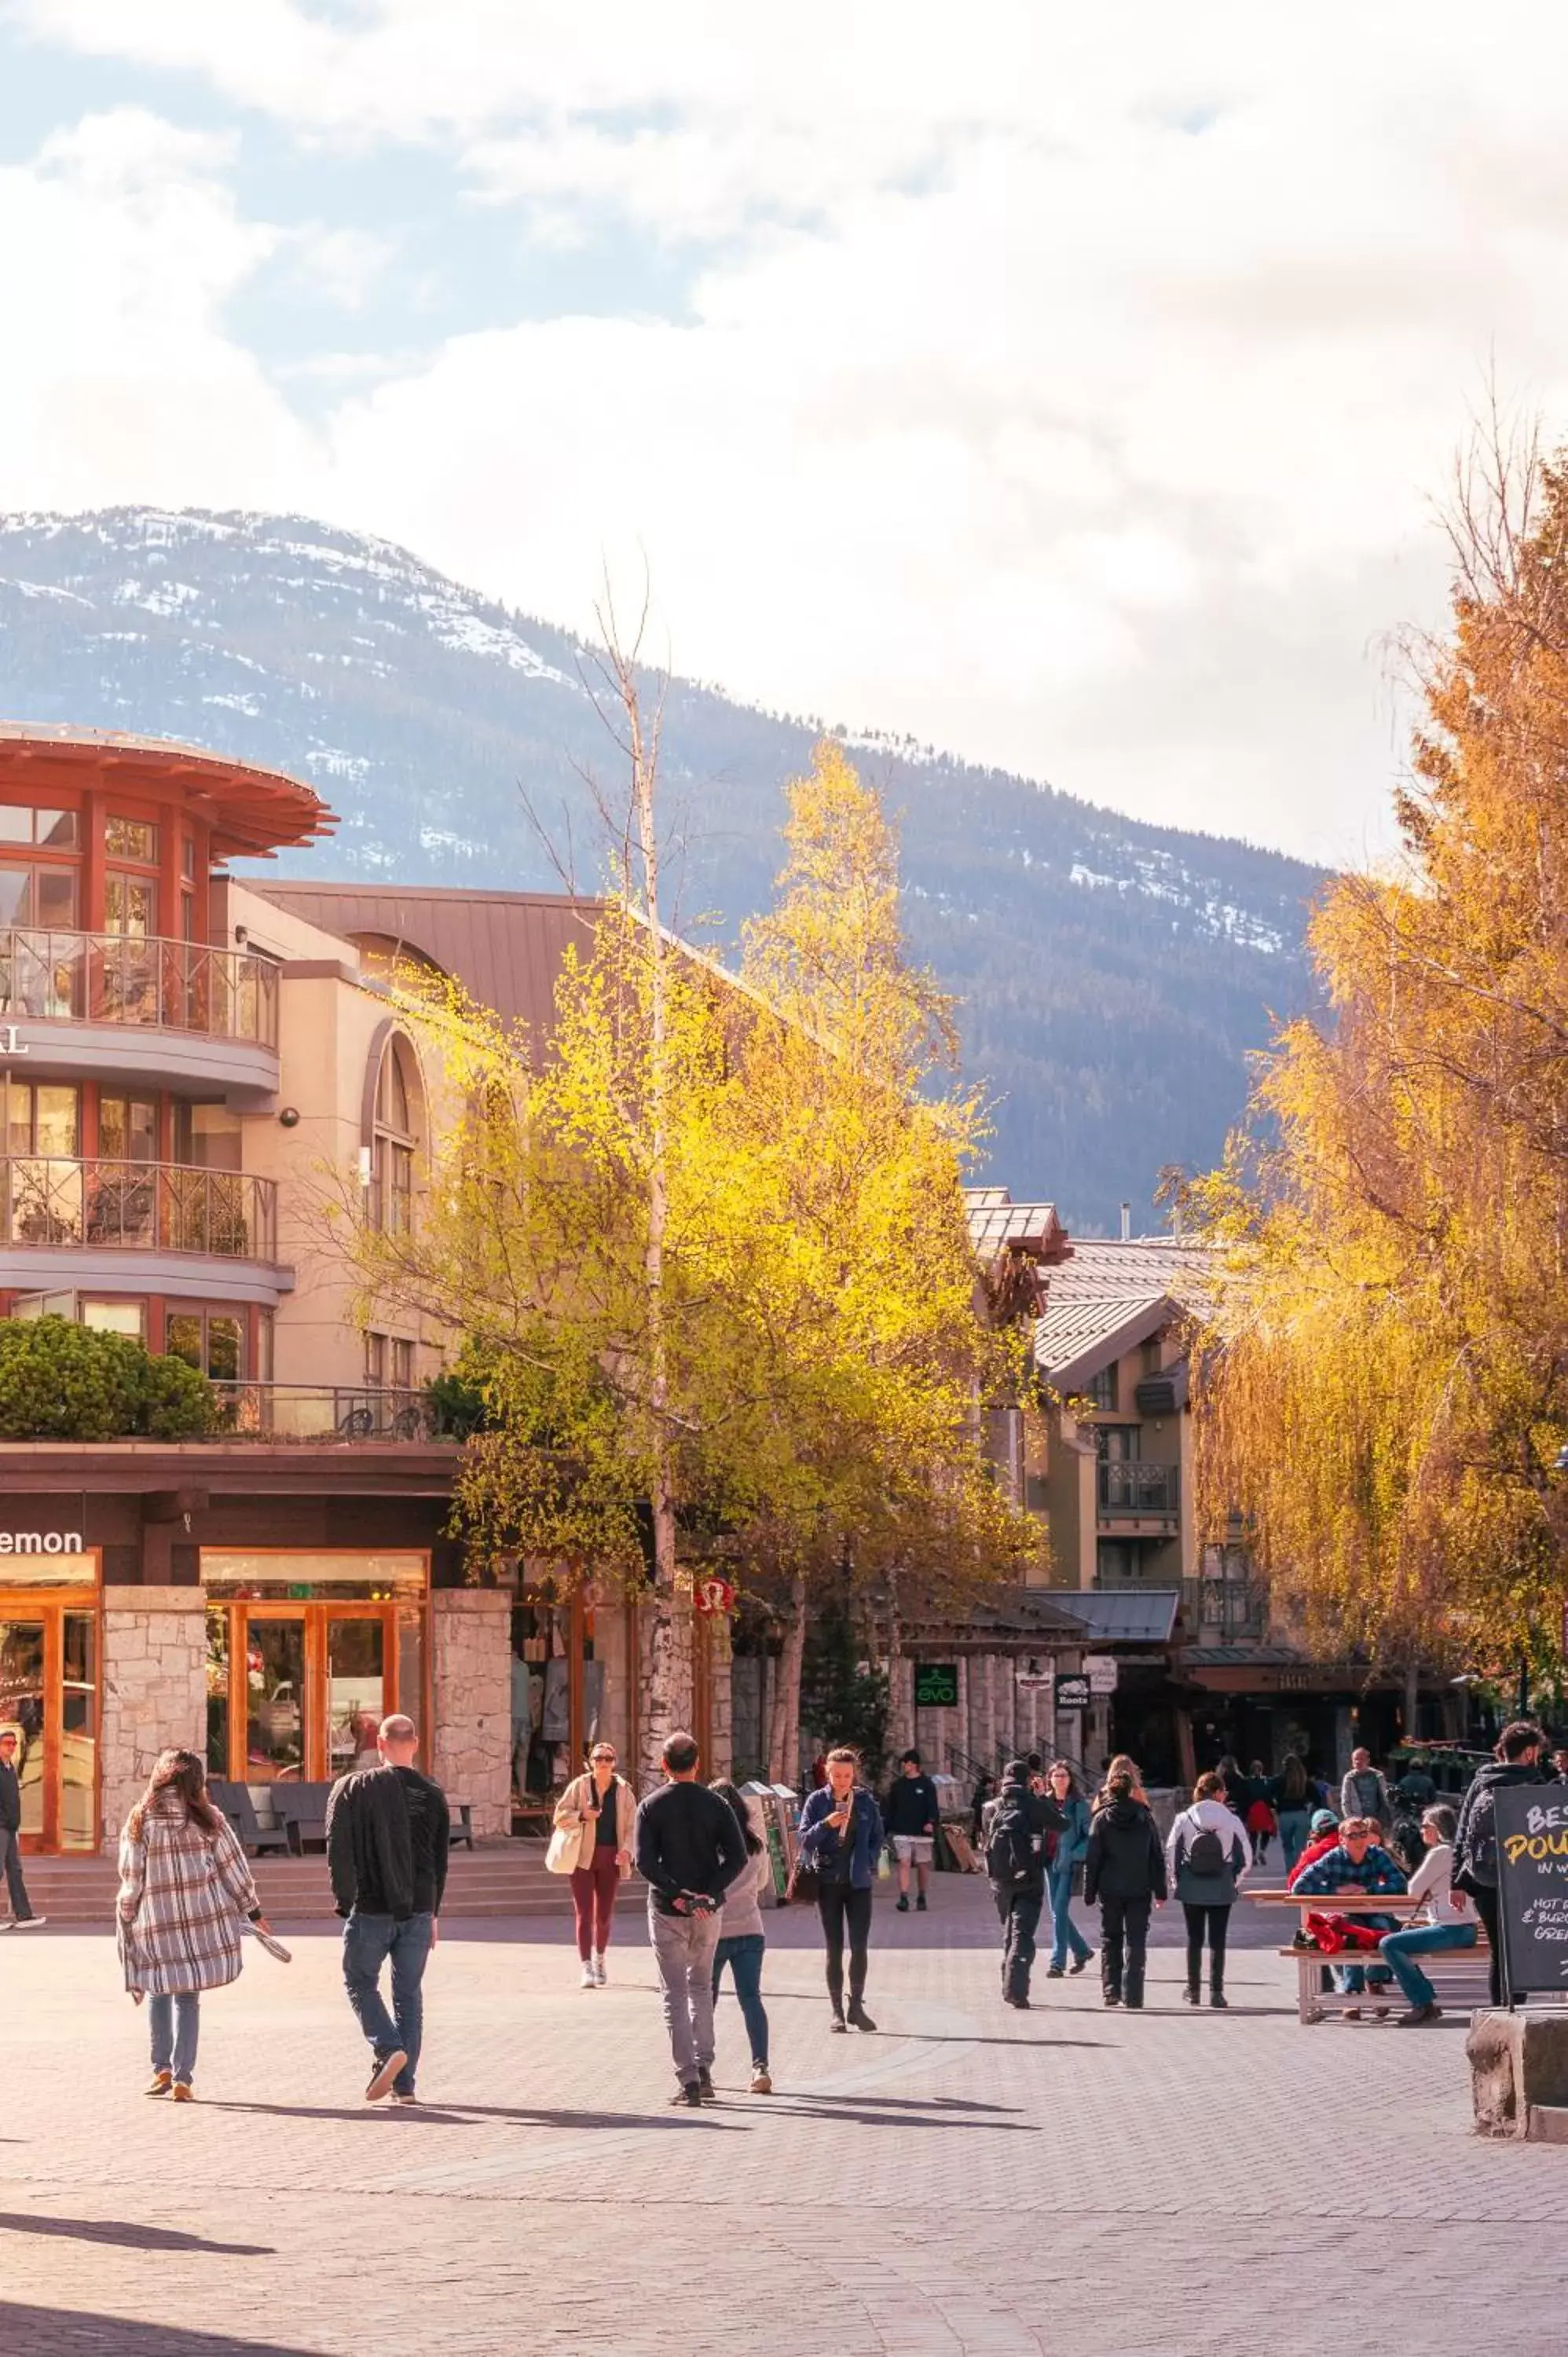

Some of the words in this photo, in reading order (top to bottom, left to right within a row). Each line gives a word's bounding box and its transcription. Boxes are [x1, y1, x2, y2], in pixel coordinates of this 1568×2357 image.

[0, 1532, 82, 1553] emon
[918, 1687, 954, 1703] evo
[1503, 1829, 1568, 1866] POU
[1537, 1862, 1553, 1874] IN
[1533, 1897, 1563, 1910] HOT
[1533, 1926, 1568, 1940] GRE
